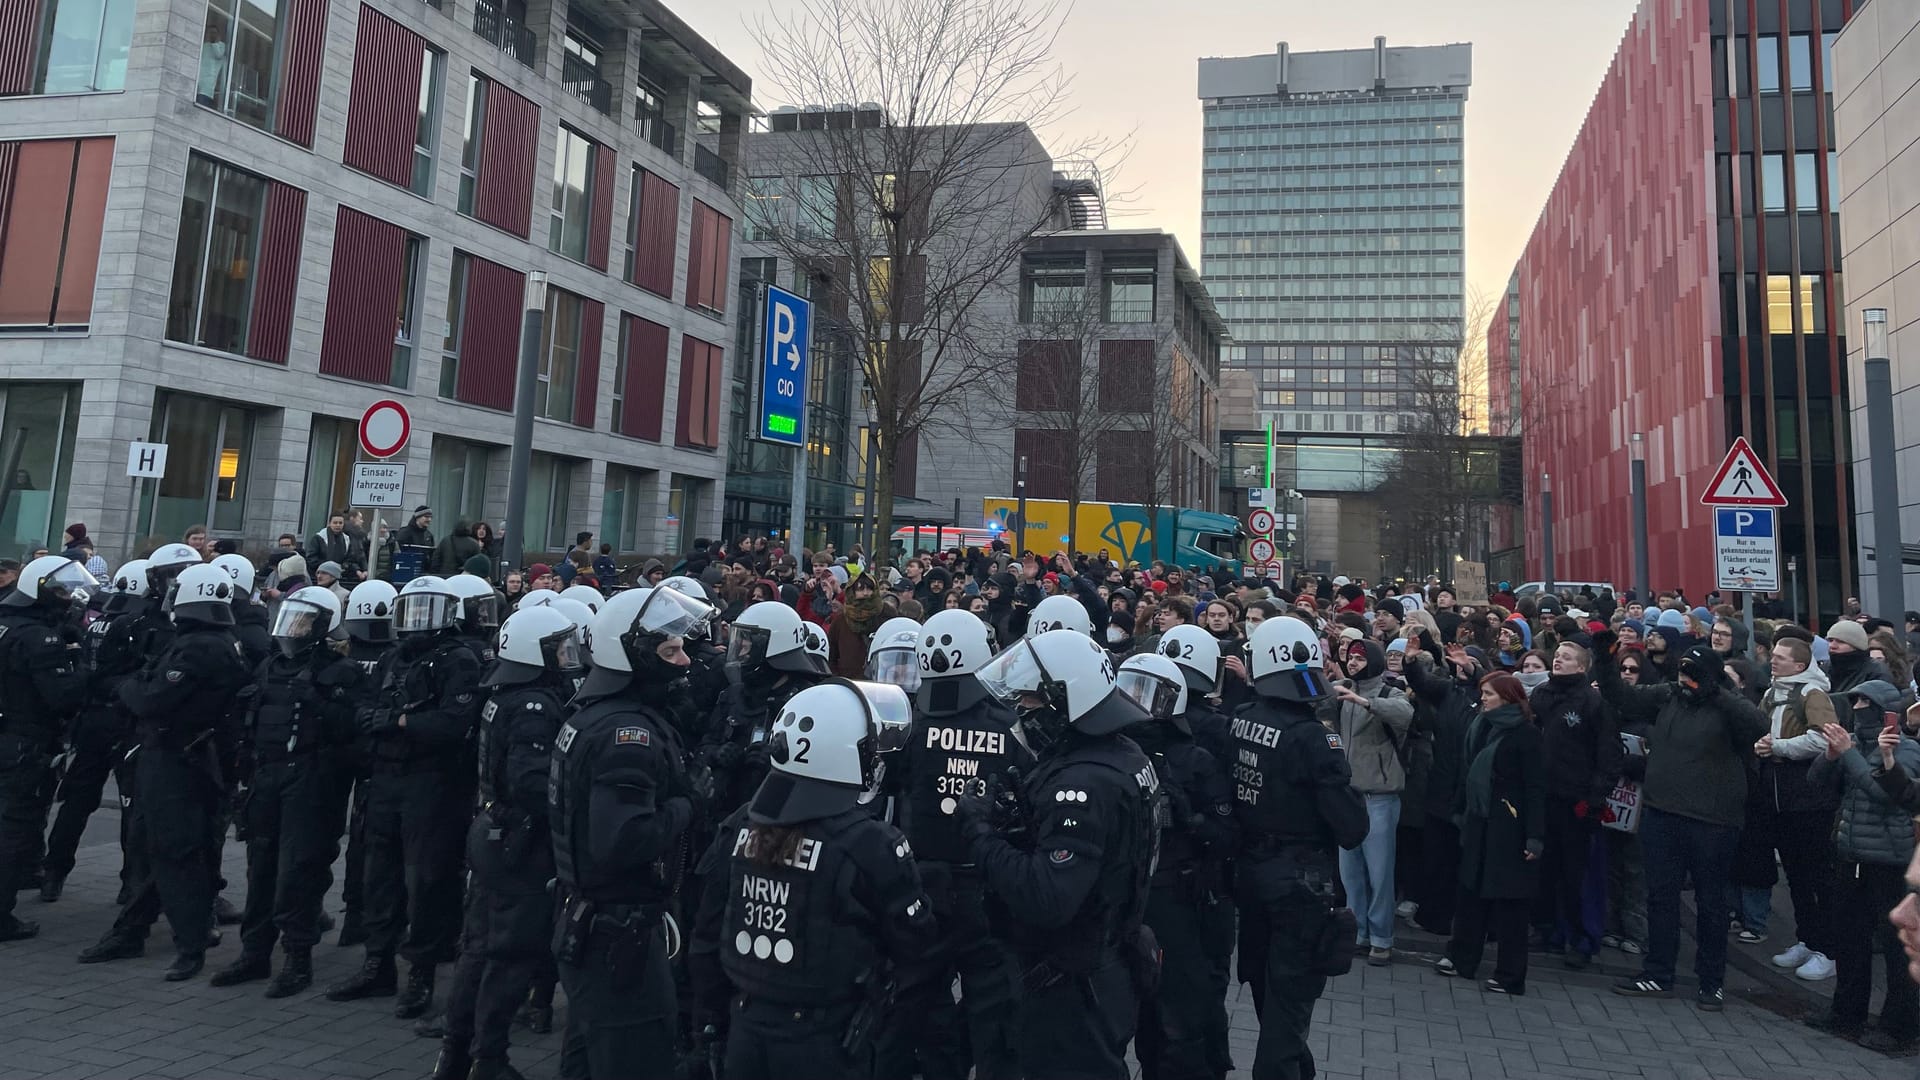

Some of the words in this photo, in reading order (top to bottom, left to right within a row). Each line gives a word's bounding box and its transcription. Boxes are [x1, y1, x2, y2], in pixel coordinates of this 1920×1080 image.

[772, 301, 794, 366] P
[777, 378, 794, 397] CIO
[139, 448, 156, 472] H
[361, 467, 398, 477] Einsatz-
[356, 480, 400, 492] fahrzeuge
[369, 493, 385, 503] frei
[1258, 516, 1266, 529] 6
[1735, 511, 1754, 535] P
[232, 568, 239, 580] 3
[129, 579, 138, 591] 3
[197, 583, 215, 597] 13
[356, 602, 372, 615] 13
[500, 633, 509, 650] 2
[820, 638, 827, 653] 2
[950, 649, 964, 669] 2
[1182, 644, 1194, 660] 2
[1268, 646, 1291, 664] 13
[1310, 642, 1319, 661] 2
[1100, 659, 1115, 685] 13
[926, 727, 1006, 755] POLIZEI
[1229, 718, 1281, 749] POLIZEI
[793, 737, 812, 764] 2
[1238, 748, 1259, 768] NRW
[947, 757, 979, 777] NRW
[1233, 763, 1263, 788] 31323
[936, 776, 986, 797] 3133
[1237, 783, 1260, 806] BAT
[742, 873, 790, 906] NRW
[744, 901, 787, 933] 3132
